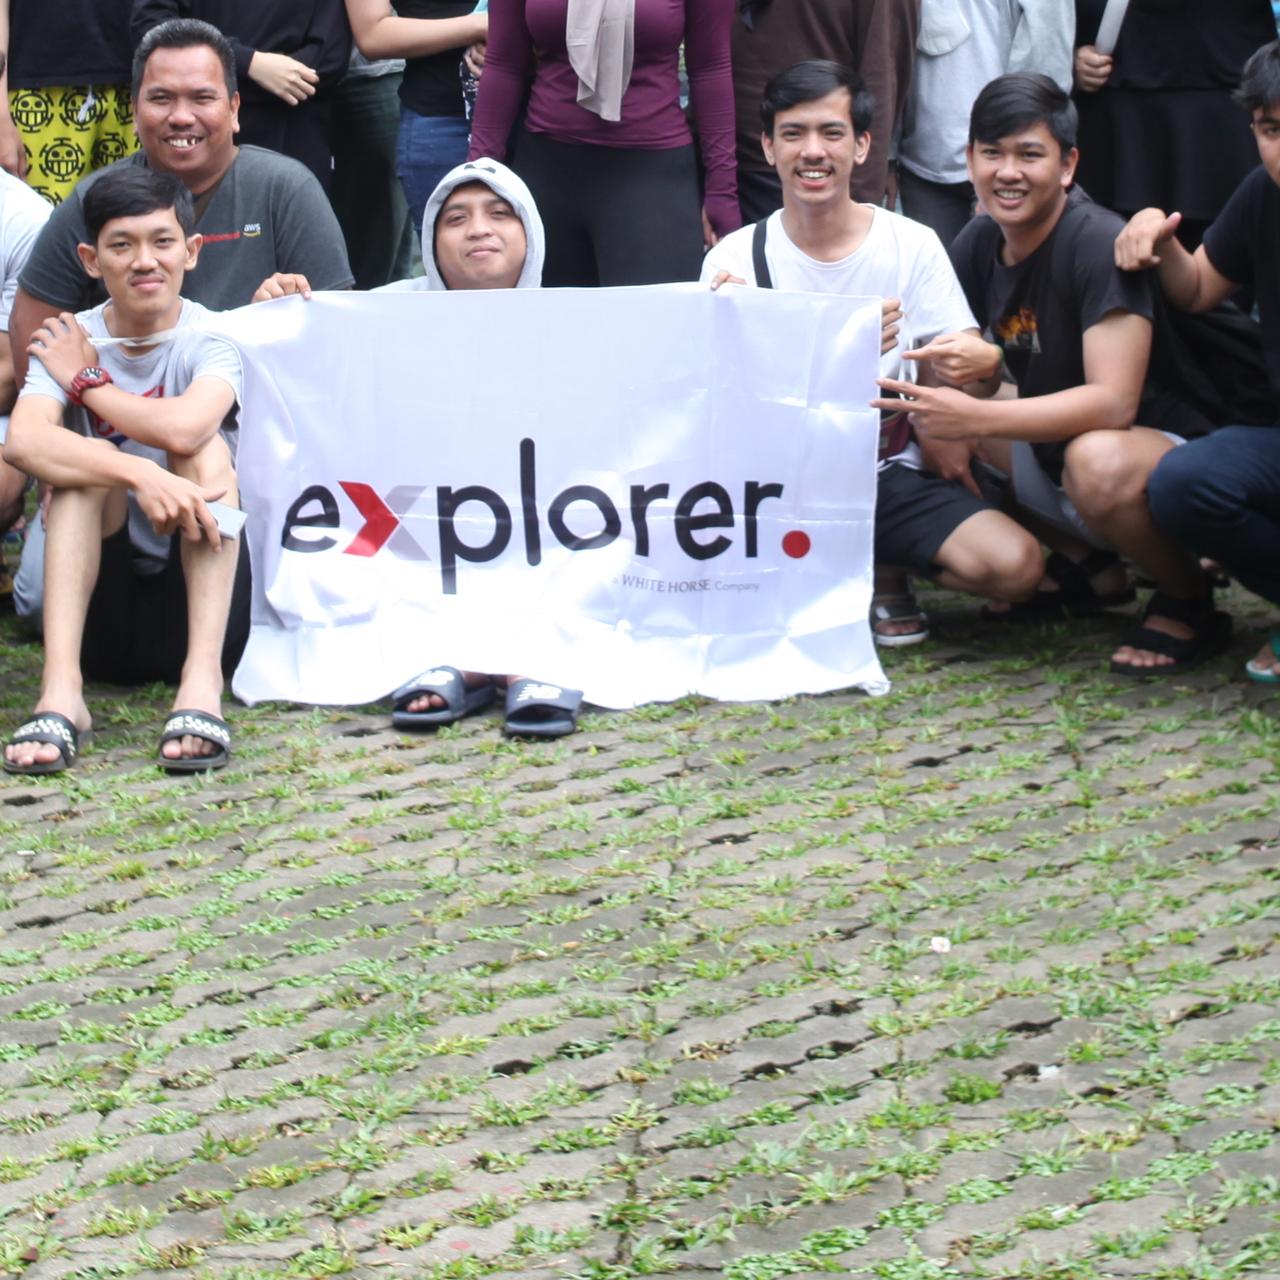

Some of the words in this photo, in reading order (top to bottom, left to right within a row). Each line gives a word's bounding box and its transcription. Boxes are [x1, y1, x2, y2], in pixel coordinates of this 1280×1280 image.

[622, 574, 665, 593] WHITE
[667, 579, 711, 593] HORSE
[714, 580, 760, 593] Company
